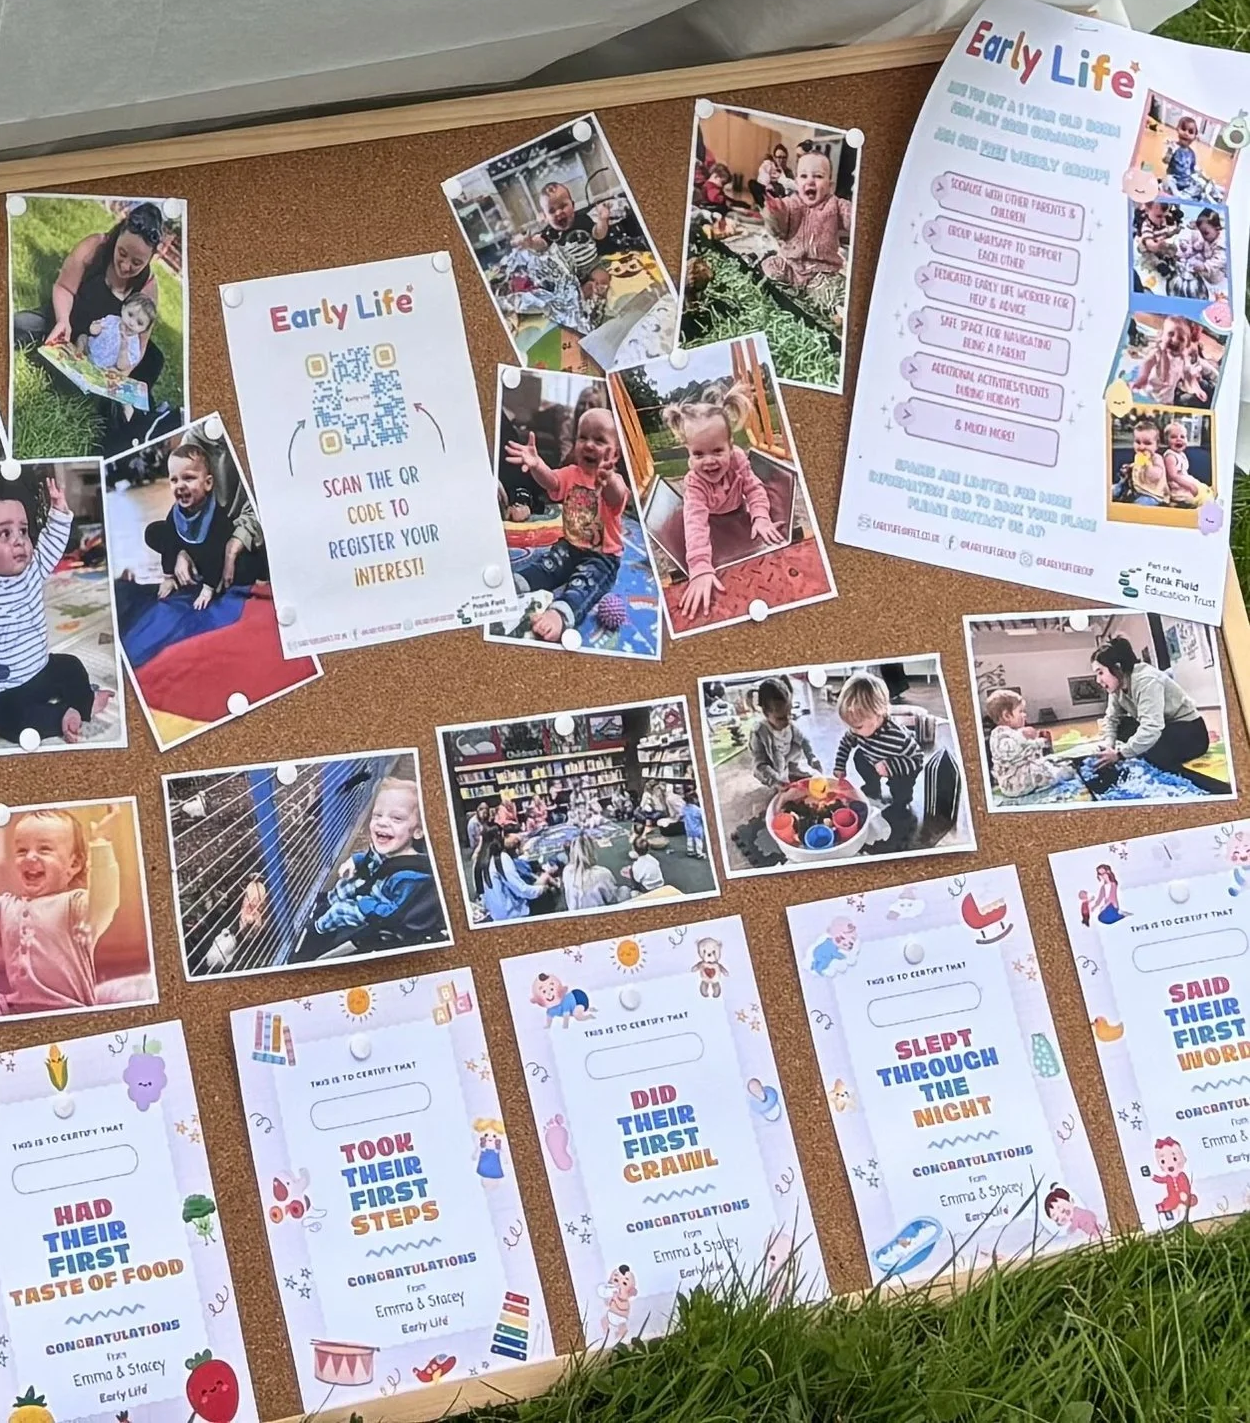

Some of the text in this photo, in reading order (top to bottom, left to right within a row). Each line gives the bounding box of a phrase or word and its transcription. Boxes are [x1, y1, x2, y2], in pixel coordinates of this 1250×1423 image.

[965, 20, 1136, 100] Early Life
[269, 287, 415, 333] Early Life
[322, 465, 420, 499] SCAN THE QR
[347, 497, 410, 525] CODE TO
[328, 523, 440, 560] REGISTER YOUR
[1145, 584, 1217, 609] Education Trust
[1146, 573, 1200, 593] Frank Field
[1168, 976, 1230, 1004] SAID
[1163, 997, 1241, 1027] THEIR
[894, 1028, 972, 1061] SLEPT
[1172, 1017, 1248, 1050] FIRST
[875, 1046, 1000, 1087] THROUGH
[630, 1084, 677, 1110] DID
[918, 1076, 970, 1103] THE
[616, 1104, 696, 1136] THEIR
[912, 1095, 992, 1128] NIGHT
[339, 1132, 415, 1164] TOOK
[622, 1126, 700, 1160] FIRST
[340, 1155, 423, 1188] THEIR
[623, 1148, 719, 1184] CRAWL
[912, 1144, 1034, 1178] CONGRATULATIONS
[349, 1177, 429, 1212] FIRST
[53, 1198, 113, 1227] HAD
[350, 1200, 440, 1236] STEPS
[626, 1198, 750, 1234] CONGRATULATIONS
[42, 1220, 128, 1254] THEIR
[47, 1242, 131, 1278] FIRST
[347, 1251, 477, 1288] CONGRATULATIONS
[8, 1258, 184, 1307] TASTE OF FOOD
[375, 1291, 465, 1318] Emma & Stacey
[45, 1319, 181, 1356] CONGRATULATIONS
[401, 1321, 428, 1335] Early
[72, 1359, 166, 1388] Emma & Stacey
